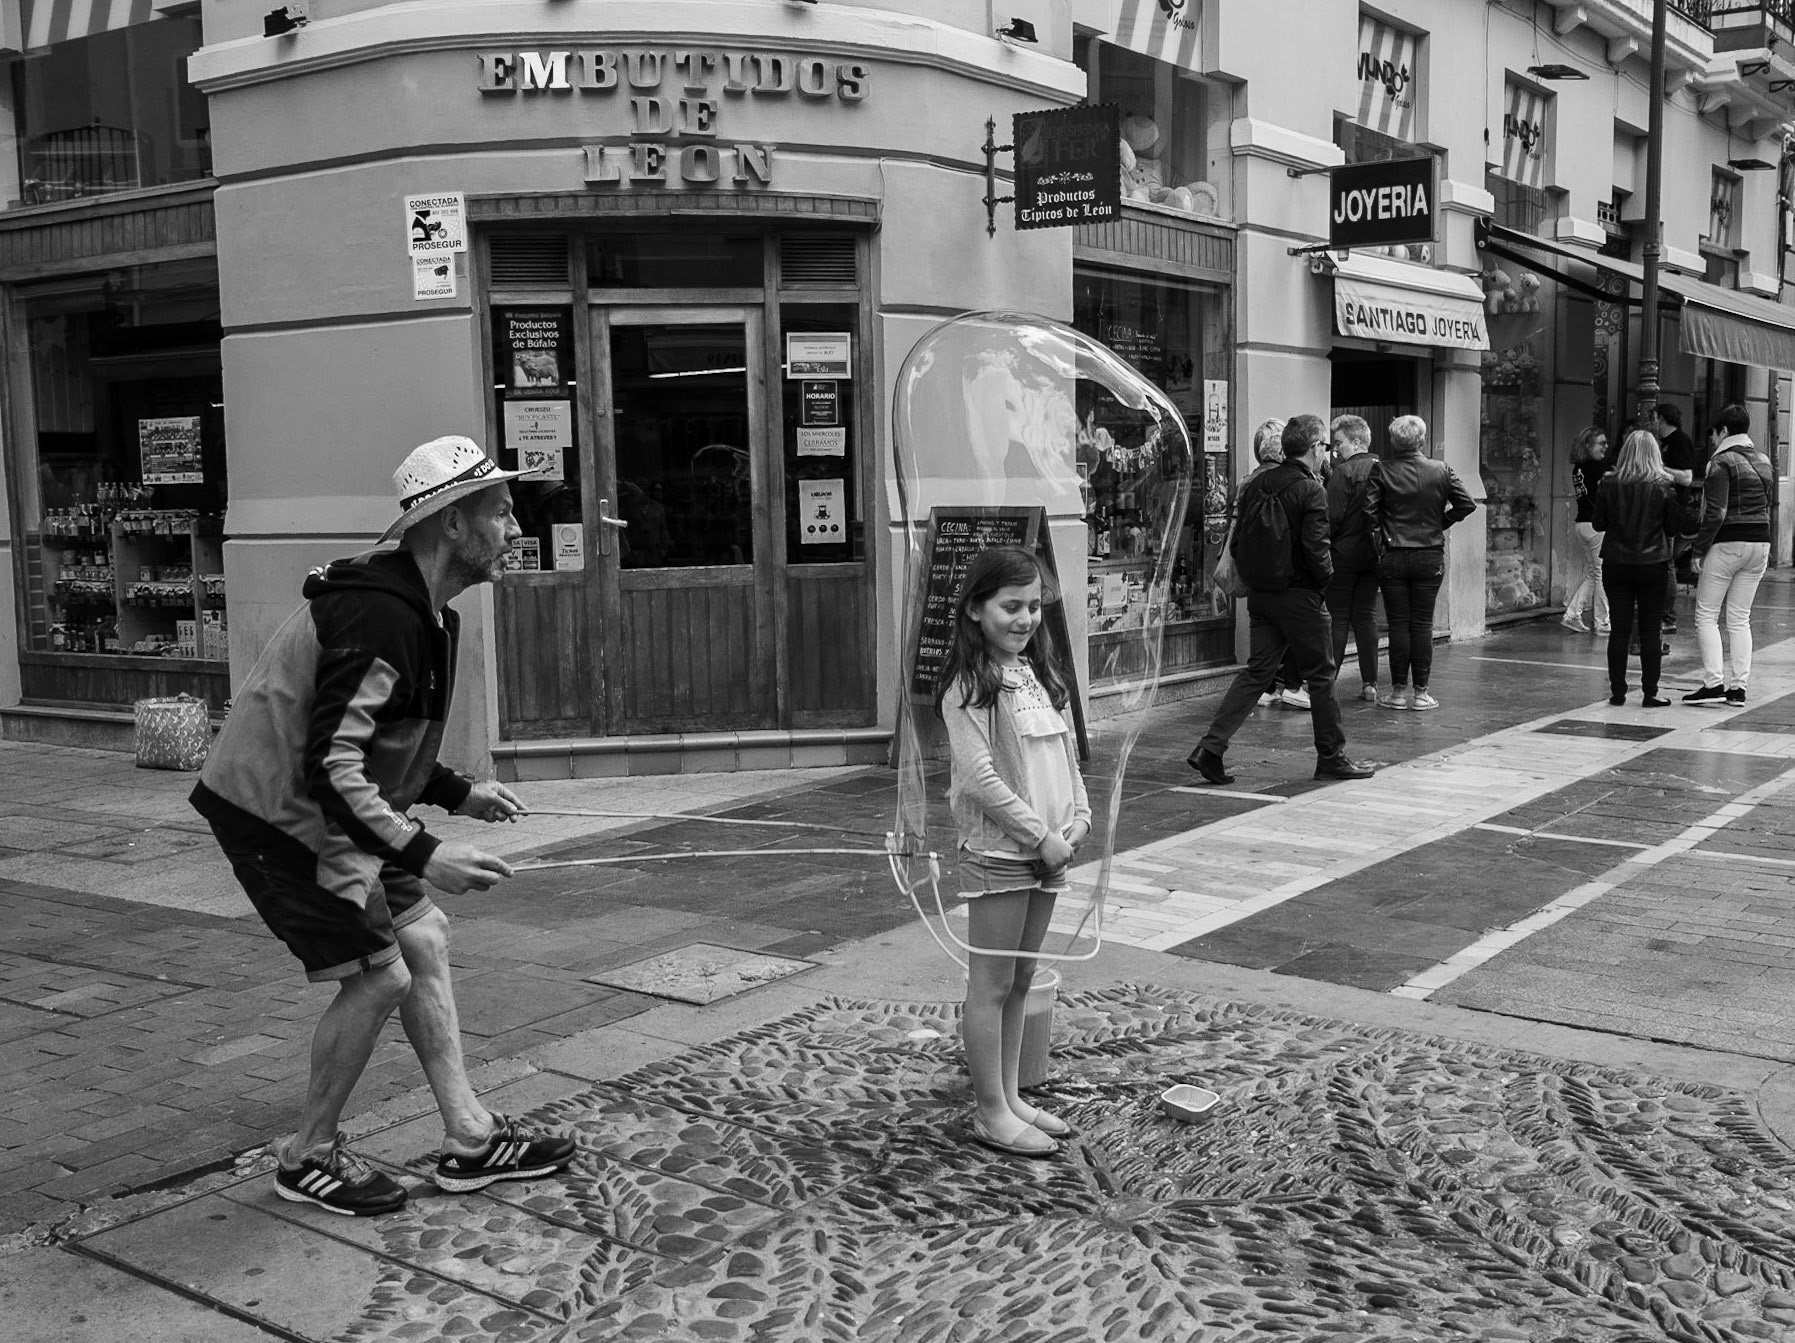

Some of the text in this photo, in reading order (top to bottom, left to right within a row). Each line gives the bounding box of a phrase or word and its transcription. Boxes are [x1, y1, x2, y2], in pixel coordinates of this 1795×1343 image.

[477, 50, 872, 100] EMBUTIDOS
[630, 97, 718, 136] DE
[582, 143, 776, 184] LEON
[409, 197, 459, 208] CONECTADA
[1036, 188, 1096, 207] Productos
[1334, 183, 1429, 224] JOYERIA
[1020, 201, 1112, 222] Típicos de León
[412, 240, 462, 251] PROSEGUR
[417, 288, 453, 296] PROSEGUR
[509, 320, 557, 330] Productos
[1345, 302, 1427, 336] SANTIAGO
[509, 330, 560, 339] Exclusivos
[512, 339, 557, 348] de Búfalo
[940, 521, 972, 533] CECINA:
